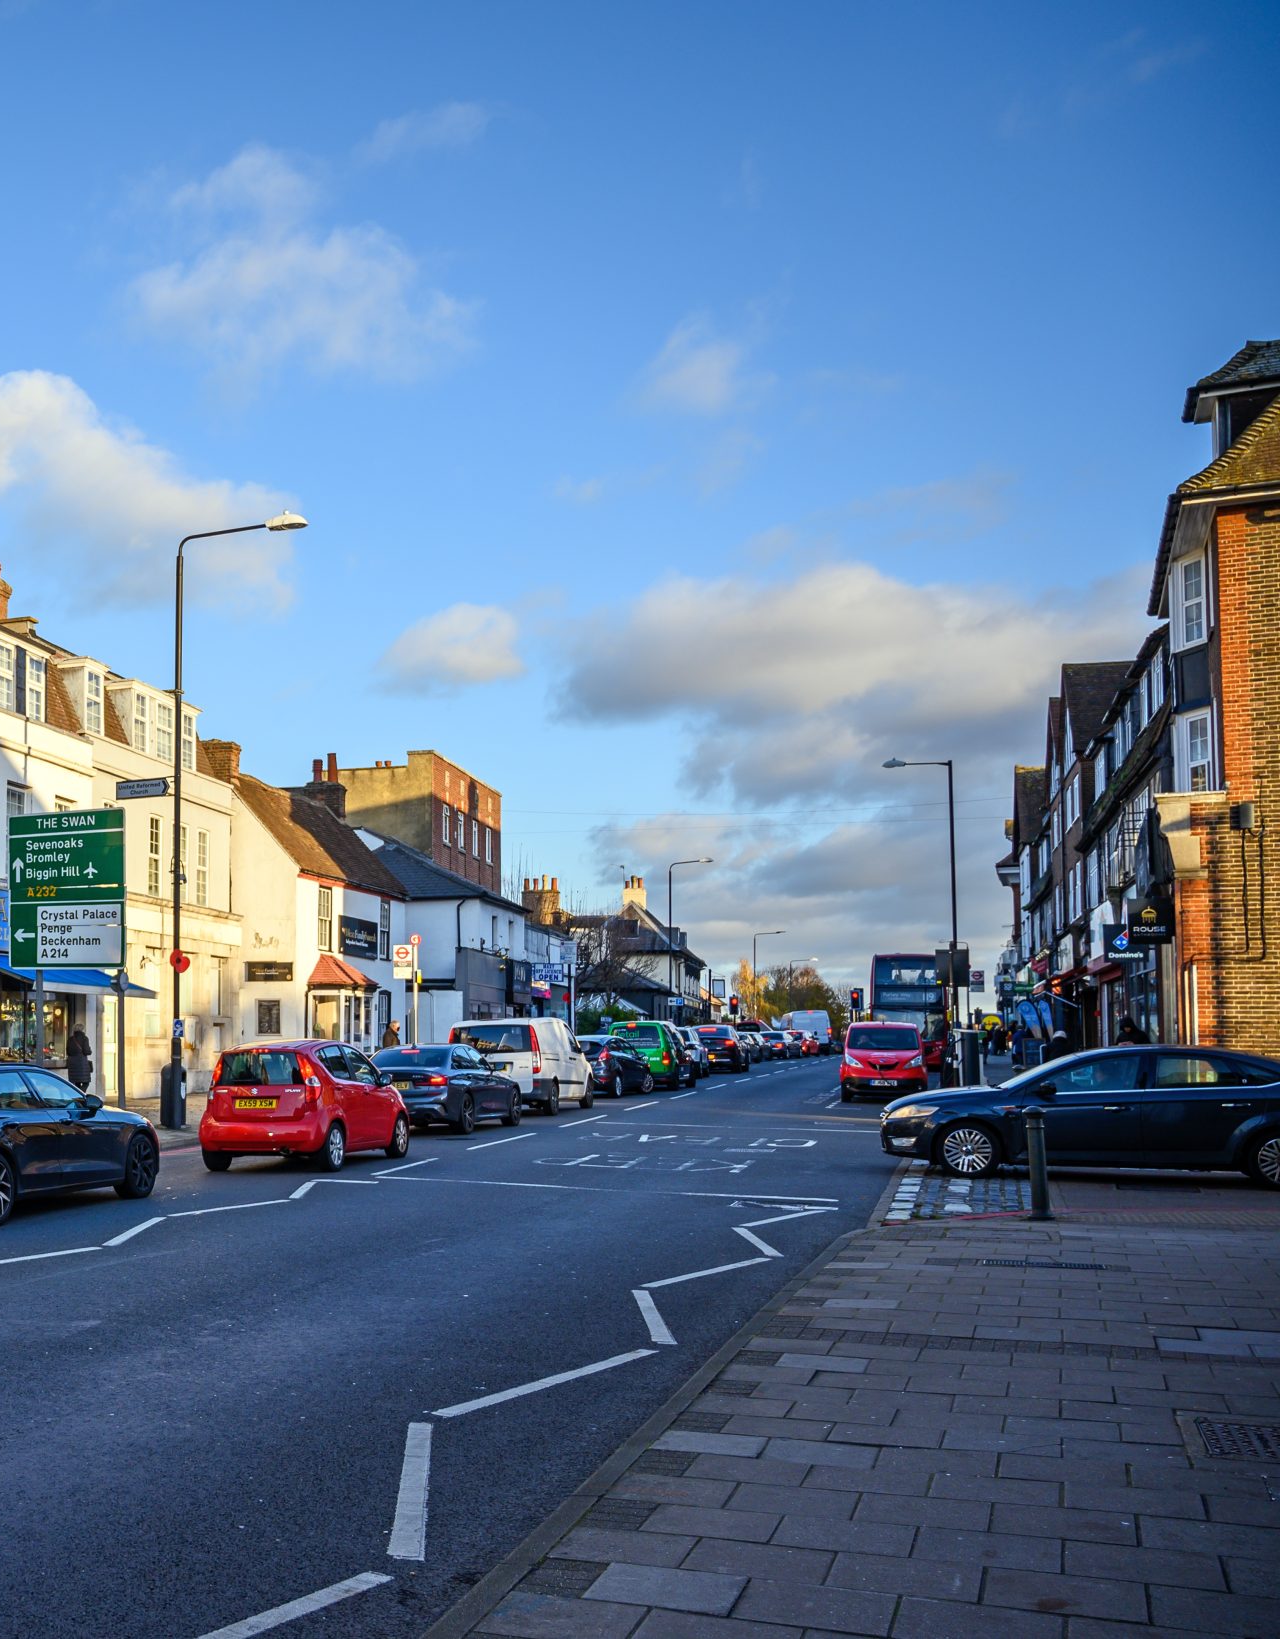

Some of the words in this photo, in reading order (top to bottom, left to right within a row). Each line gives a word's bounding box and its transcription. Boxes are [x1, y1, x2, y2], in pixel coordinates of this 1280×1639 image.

[36, 817, 58, 829] THE
[61, 815, 96, 828] SWAN
[25, 838, 84, 851] Sevenoaks
[25, 852, 71, 865] Bromley
[25, 867, 59, 881] Biggin
[61, 866, 81, 877] Hill
[40, 910, 79, 922] Crystal
[82, 909, 118, 920] Palace
[40, 924, 73, 935] Penge
[40, 936, 101, 946] Beckenham
